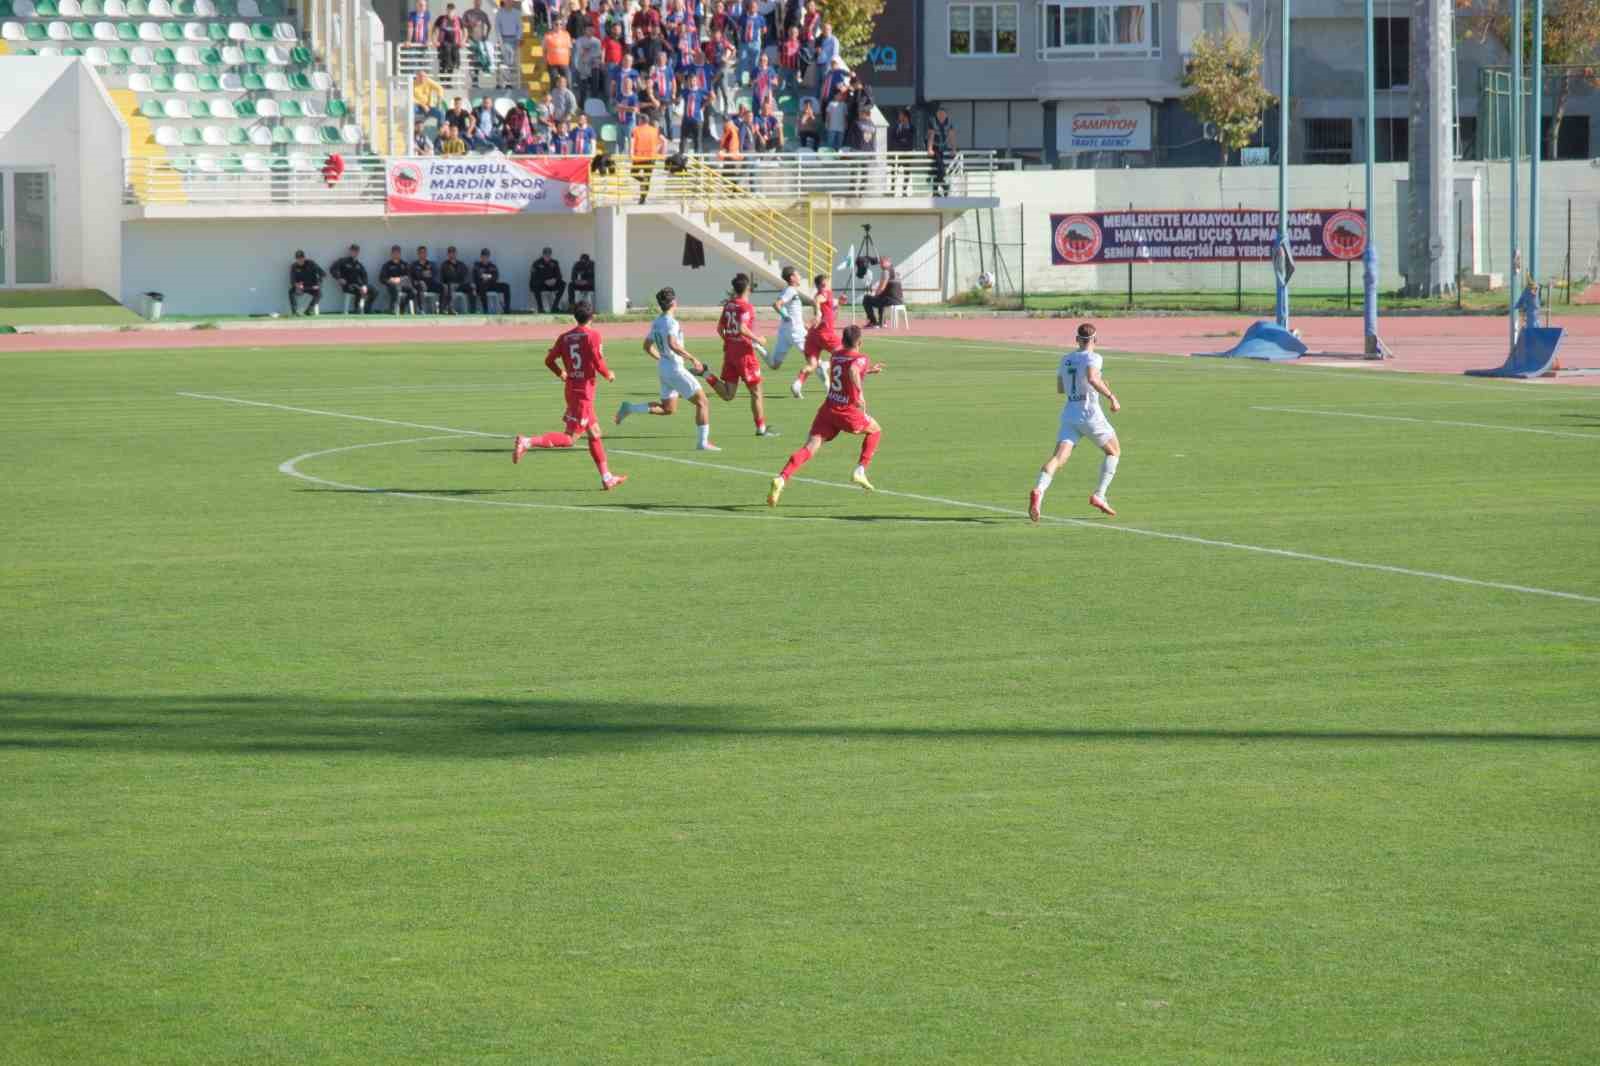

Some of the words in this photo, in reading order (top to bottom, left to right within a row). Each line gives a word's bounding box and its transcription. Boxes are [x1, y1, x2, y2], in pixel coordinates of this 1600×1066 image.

[430, 161, 509, 175] İSTANBUL
[430, 176, 496, 190] MARDİN
[500, 178, 545, 190] SPOR
[431, 192, 491, 202] TARAFTAR
[1104, 213, 1180, 228] MEMLEKETTE
[1182, 213, 1263, 227] KARAYOLLARI
[1114, 228, 1196, 242] HAVAYOLLARI
[1198, 228, 1233, 244] UÇUŞ
[1173, 243, 1213, 259] GEÇTİĞİ
[1214, 245, 1235, 257] HER
[1238, 245, 1269, 257] YERDE
[569, 343, 582, 369] 5
[831, 365, 843, 392] 3
[1067, 368, 1077, 394] 7
